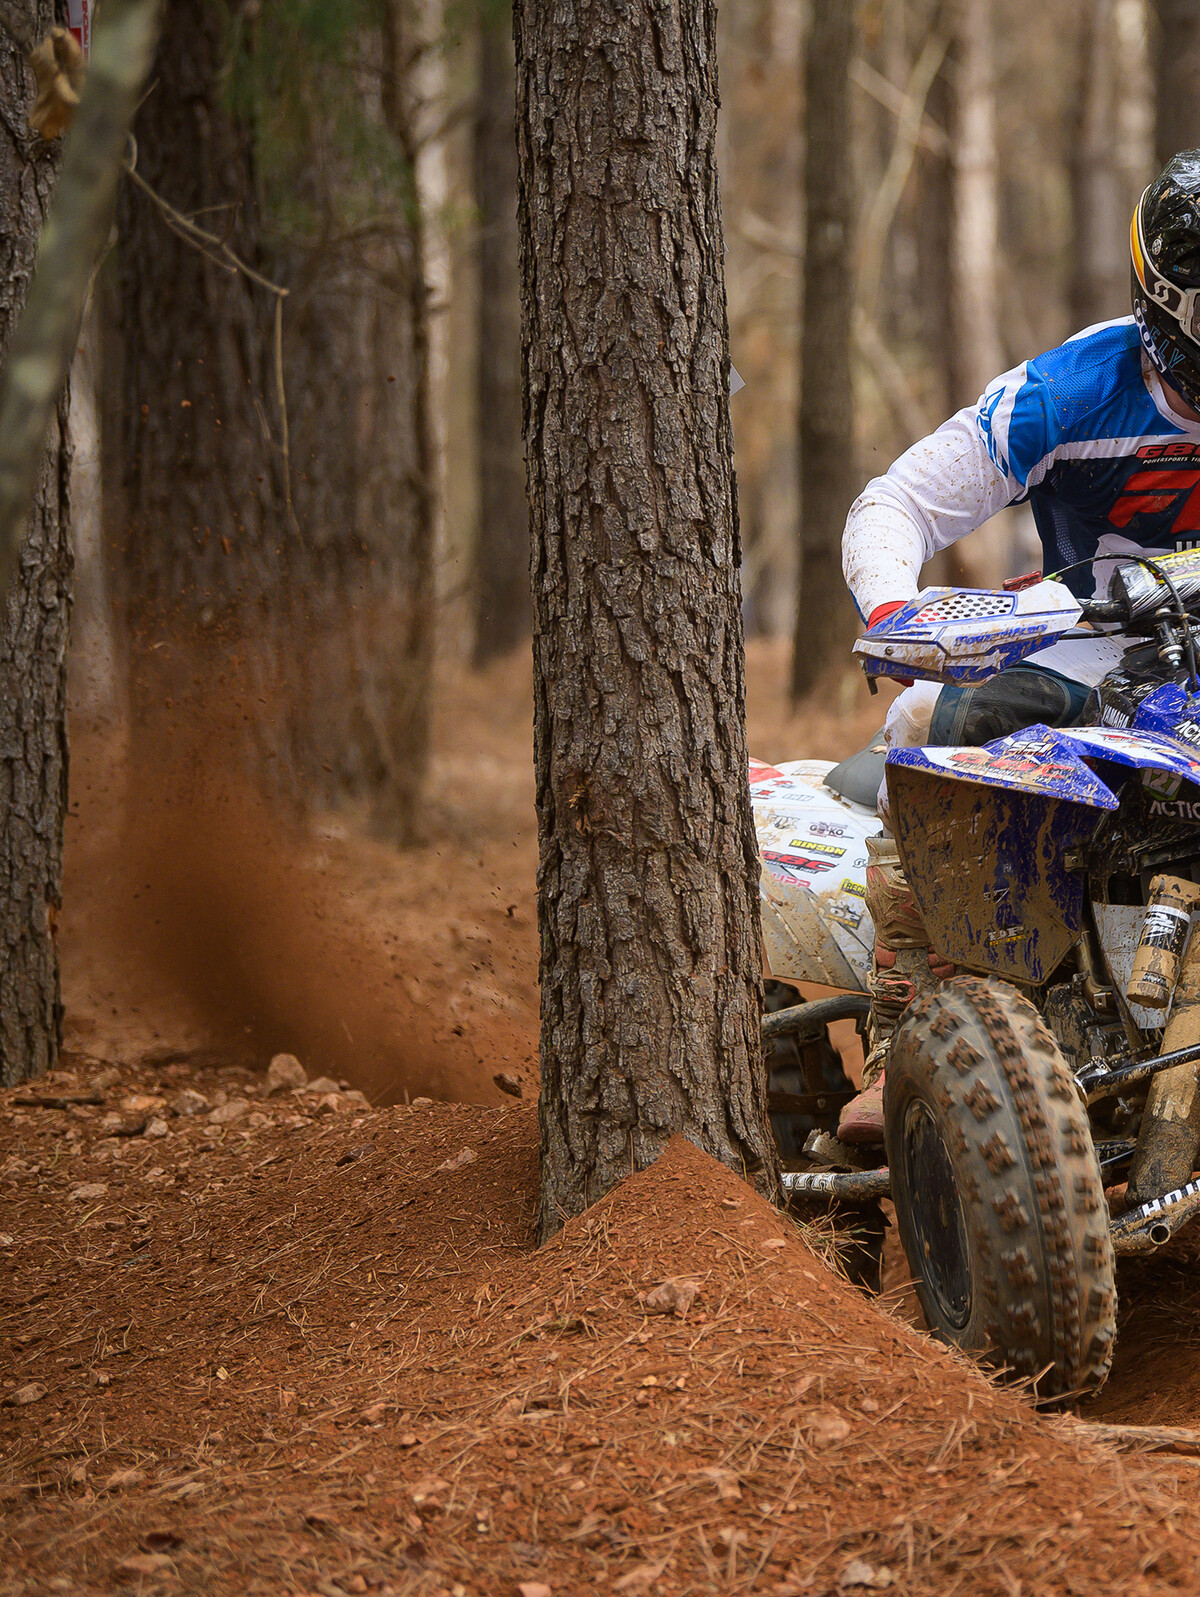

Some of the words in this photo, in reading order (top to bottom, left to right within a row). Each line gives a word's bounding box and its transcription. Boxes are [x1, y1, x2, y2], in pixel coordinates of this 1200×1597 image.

[1149, 325, 1186, 369] FLY
[1142, 456, 1189, 465] POWERSPORTS
[1141, 767, 1183, 796] 127
[789, 839, 845, 856] HINSON
[761, 850, 838, 873] GBC
